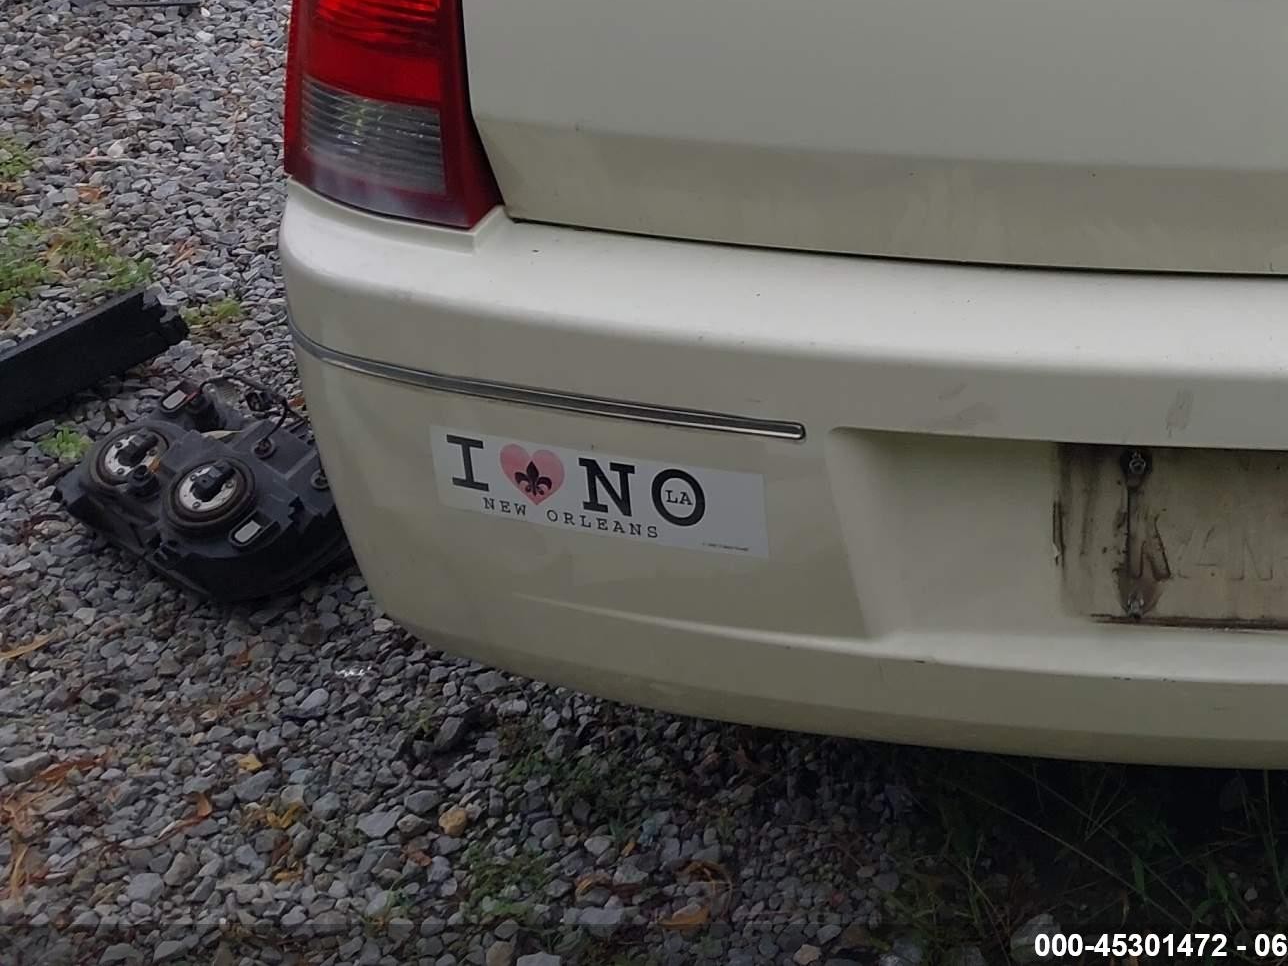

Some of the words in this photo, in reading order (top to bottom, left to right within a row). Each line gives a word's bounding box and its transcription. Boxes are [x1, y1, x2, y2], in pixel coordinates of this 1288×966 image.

[446, 434, 490, 492] I
[483, 497, 527, 517] NEW
[546, 509, 659, 539] ORLEANS
[665, 489, 693, 506] LA
